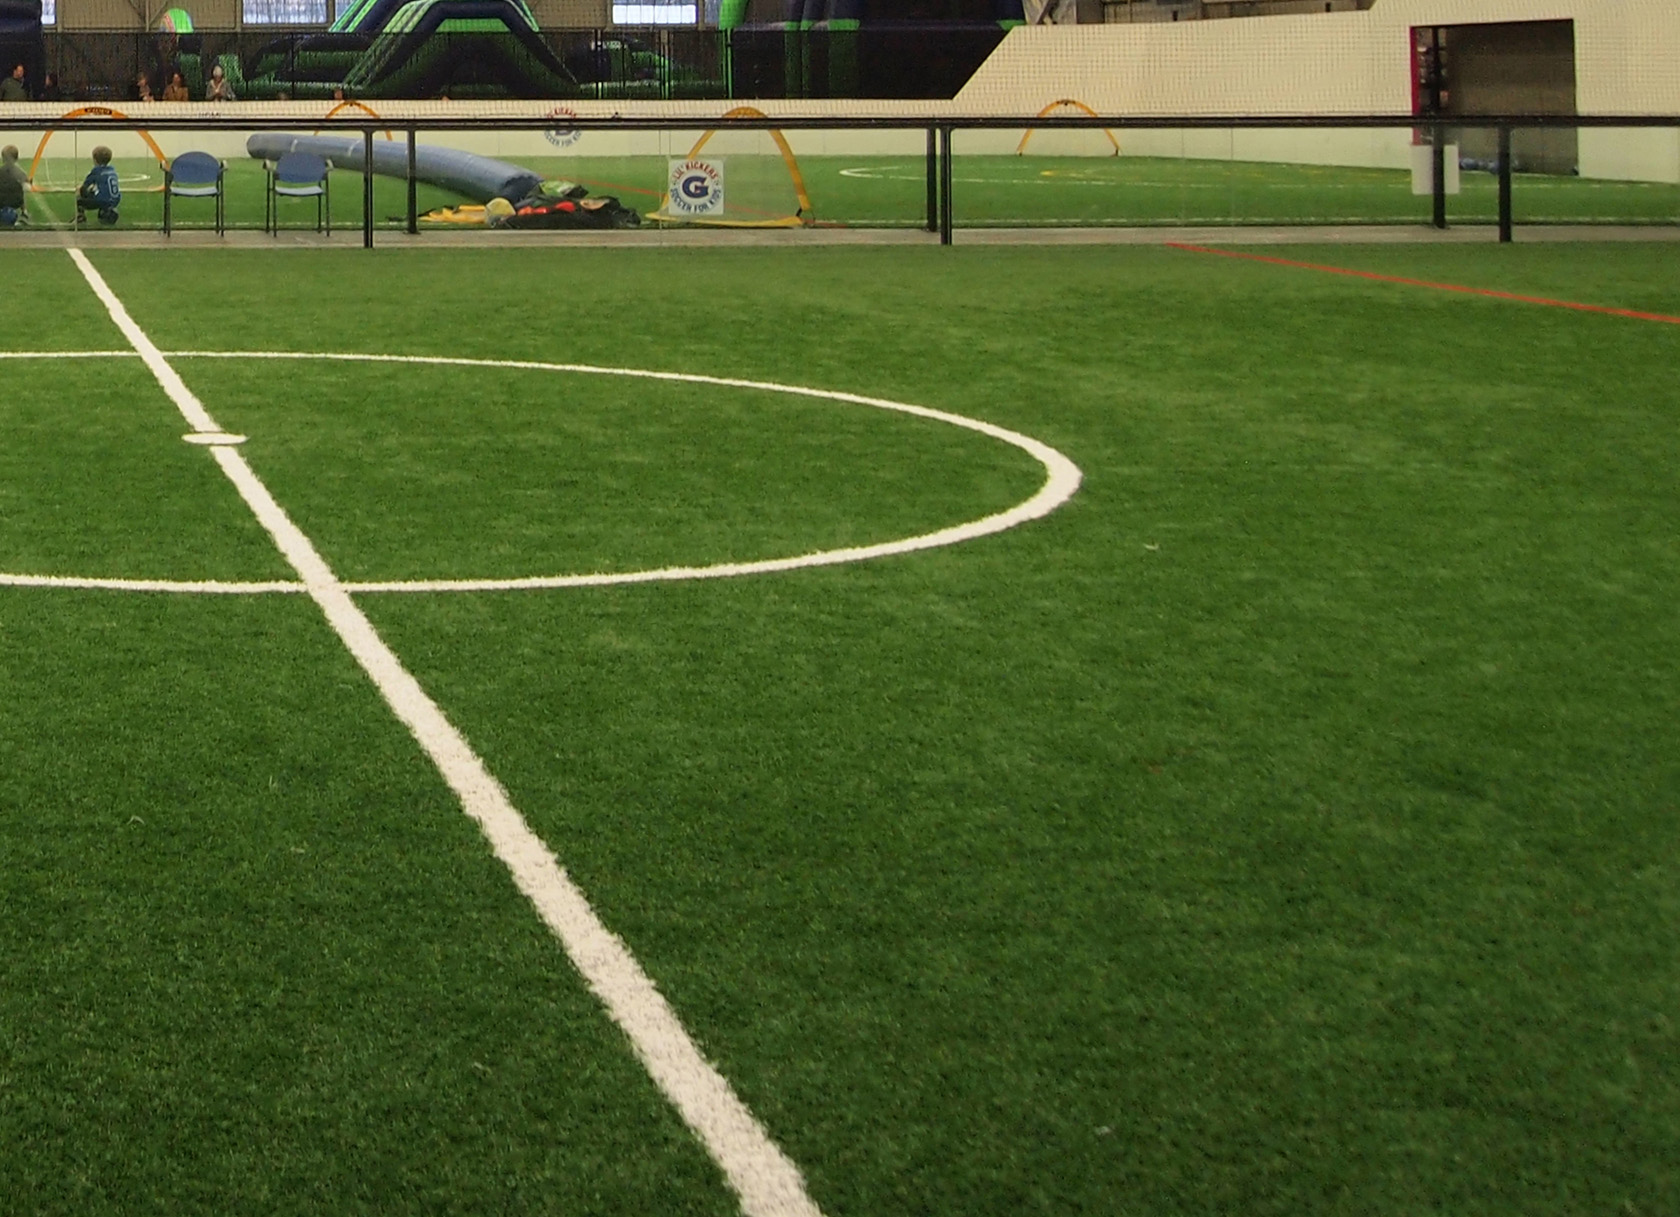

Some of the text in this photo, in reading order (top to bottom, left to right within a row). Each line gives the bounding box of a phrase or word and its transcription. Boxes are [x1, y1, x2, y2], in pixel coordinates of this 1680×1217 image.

[685, 160, 719, 179] KICKERS
[682, 175, 709, 199] G
[670, 187, 722, 212] SOCCER FOR KIDS
